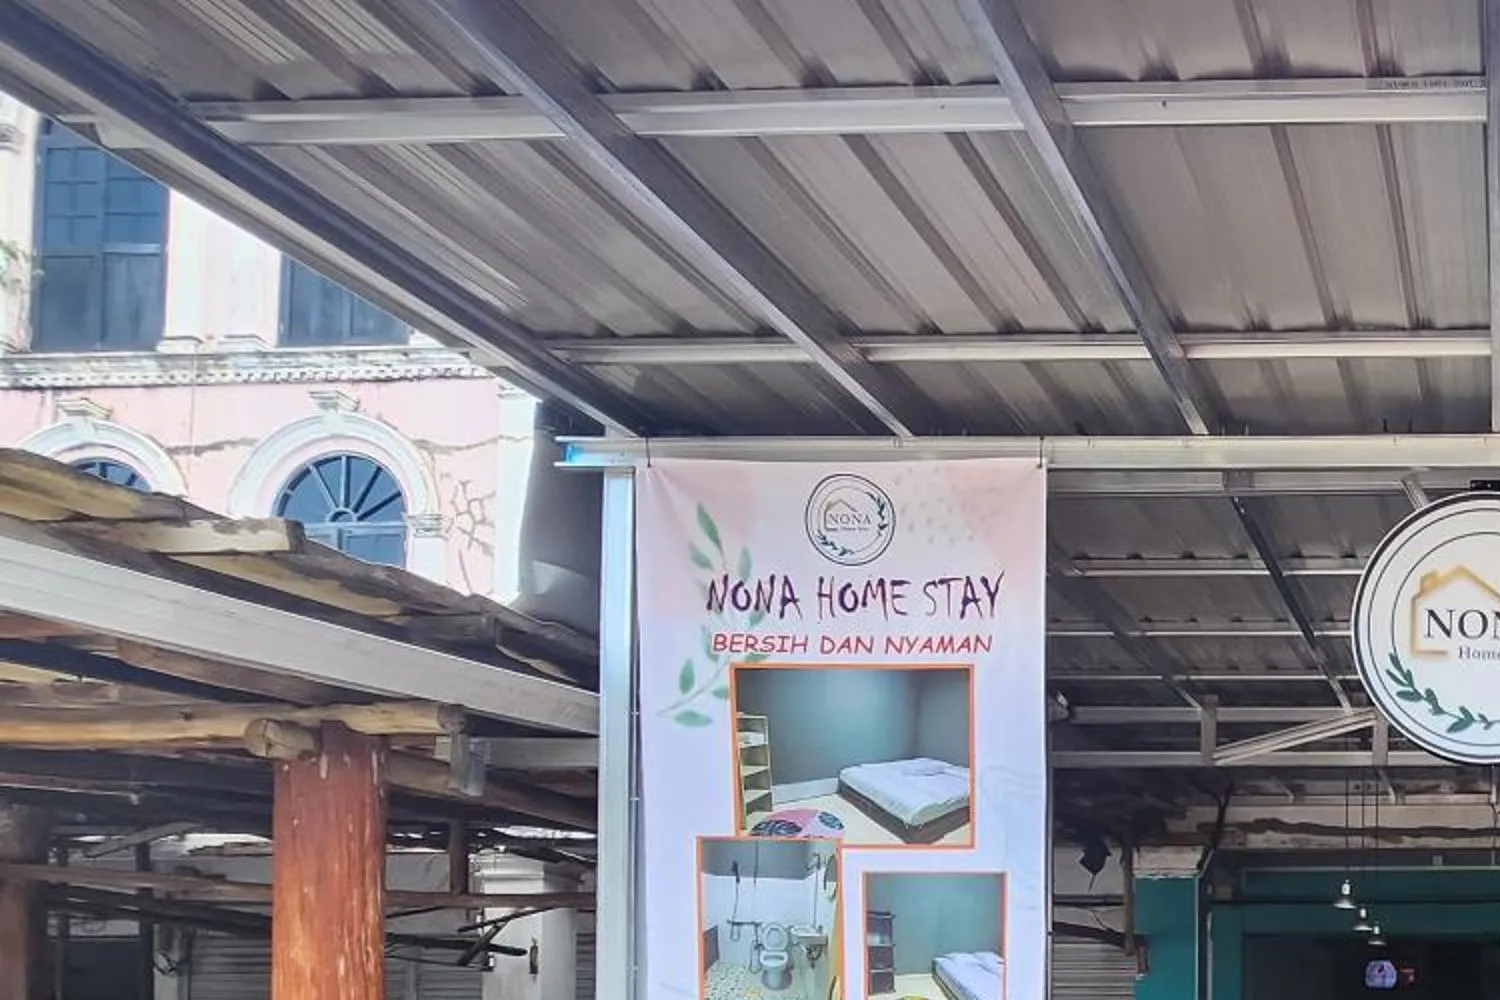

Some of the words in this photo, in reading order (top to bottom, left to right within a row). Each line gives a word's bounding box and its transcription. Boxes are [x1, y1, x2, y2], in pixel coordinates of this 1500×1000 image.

[706, 574, 802, 620] NONA
[817, 575, 912, 621] HOME
[923, 570, 1005, 620] STAY
[713, 633, 808, 653] BERSIH
[820, 635, 873, 654] DAN
[885, 635, 992, 654] NYAMAN
